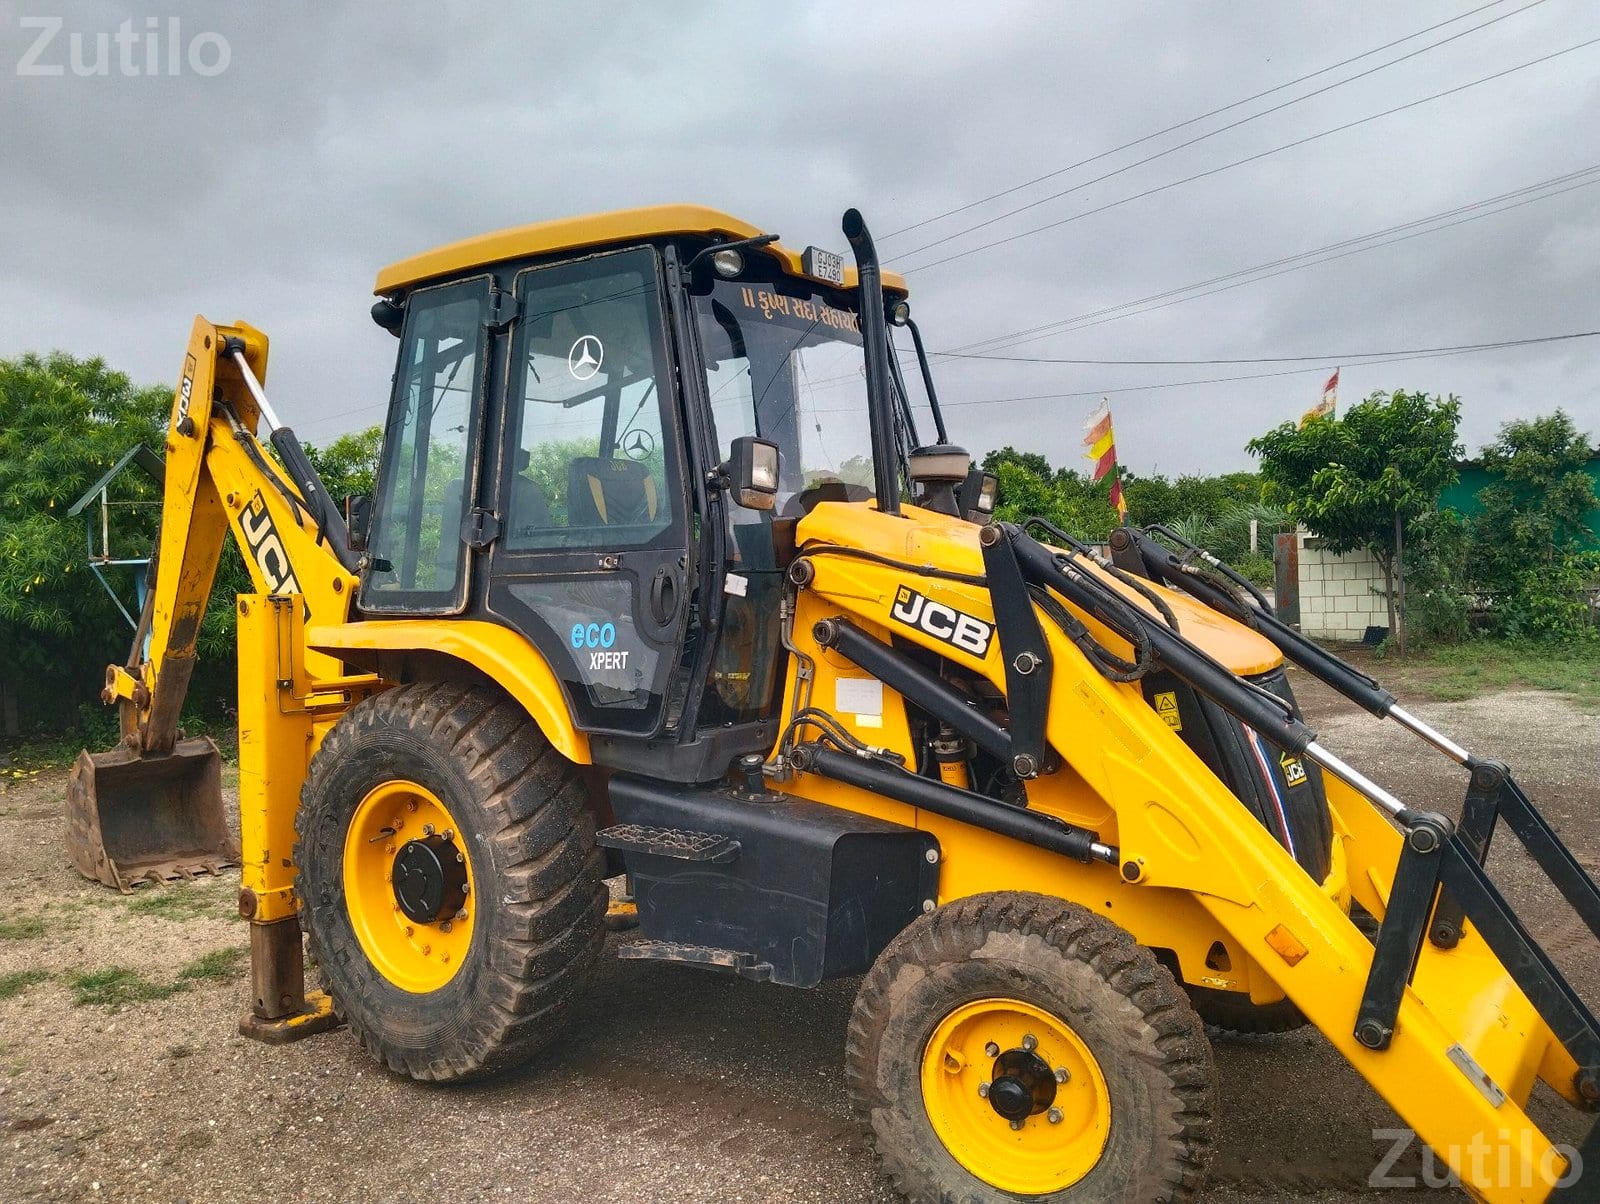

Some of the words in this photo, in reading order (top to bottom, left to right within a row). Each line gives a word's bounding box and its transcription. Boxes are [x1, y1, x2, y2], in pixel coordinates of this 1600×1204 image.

[571, 622, 616, 648] eco
[893, 594, 991, 655] JCB
[589, 651, 629, 670] XPERT
